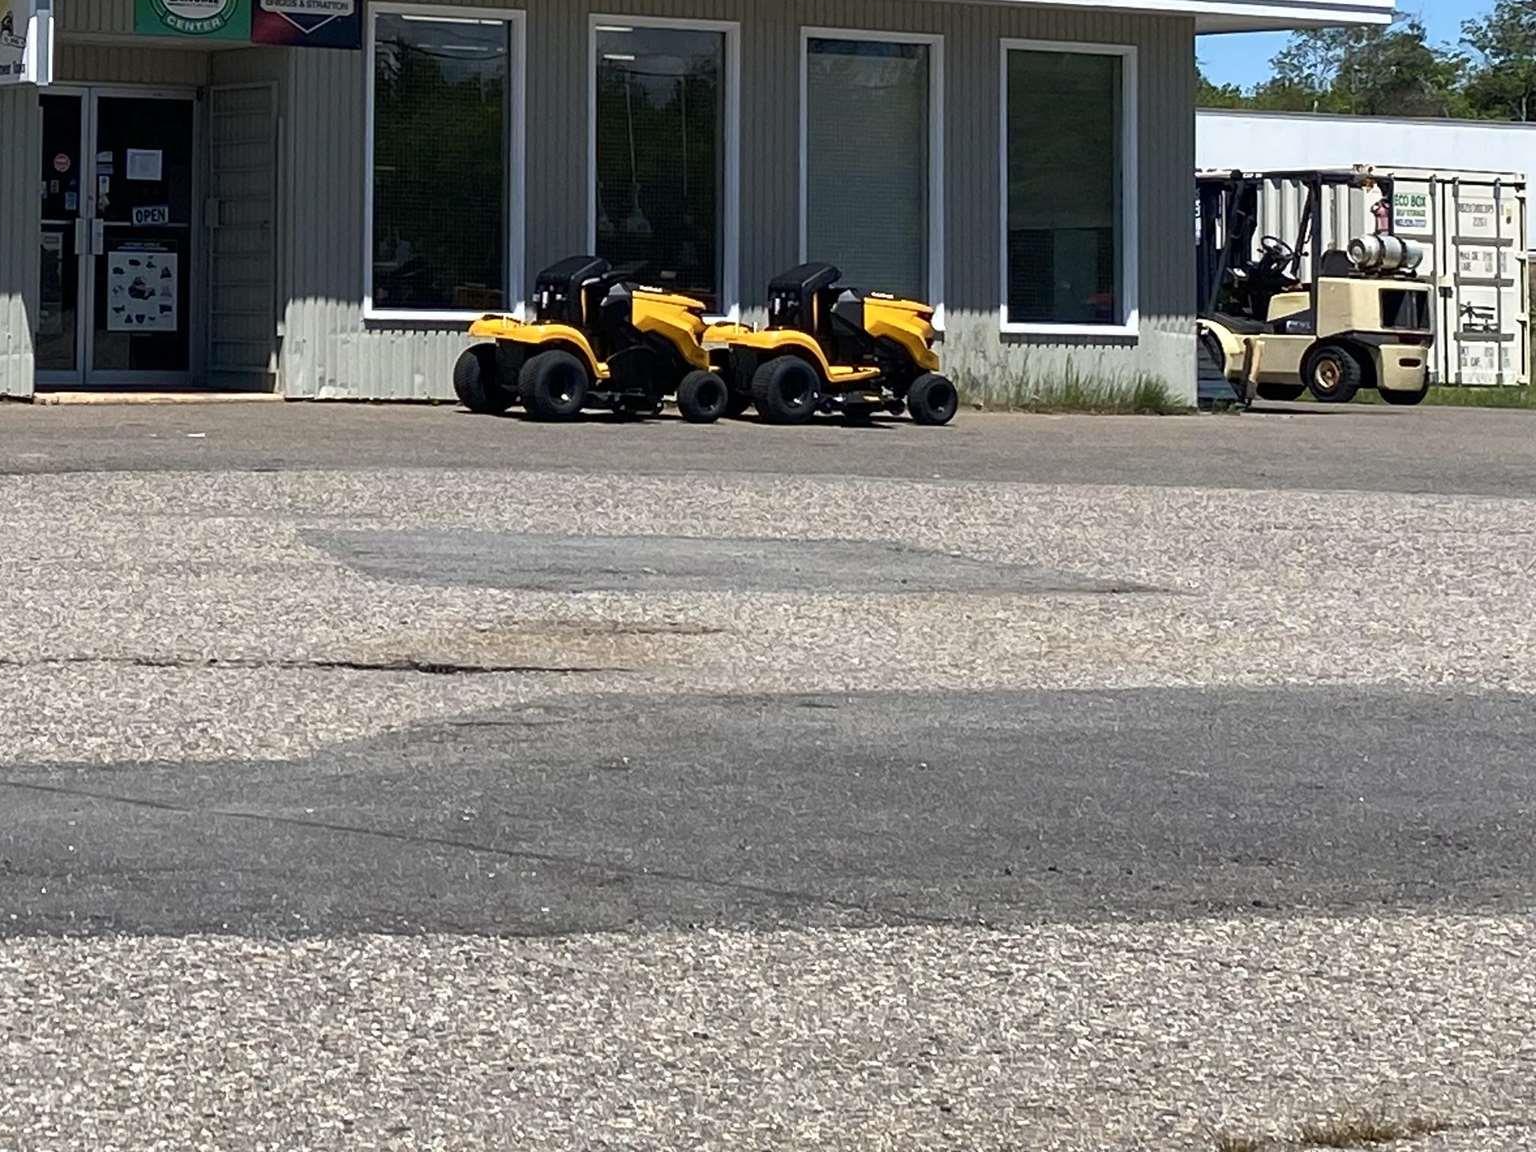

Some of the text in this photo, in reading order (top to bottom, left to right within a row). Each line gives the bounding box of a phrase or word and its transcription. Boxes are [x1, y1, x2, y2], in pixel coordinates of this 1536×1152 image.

[306, 0, 349, 10] STRATTON
[167, 16, 220, 31] CENTER
[135, 209, 165, 223] OPEN
